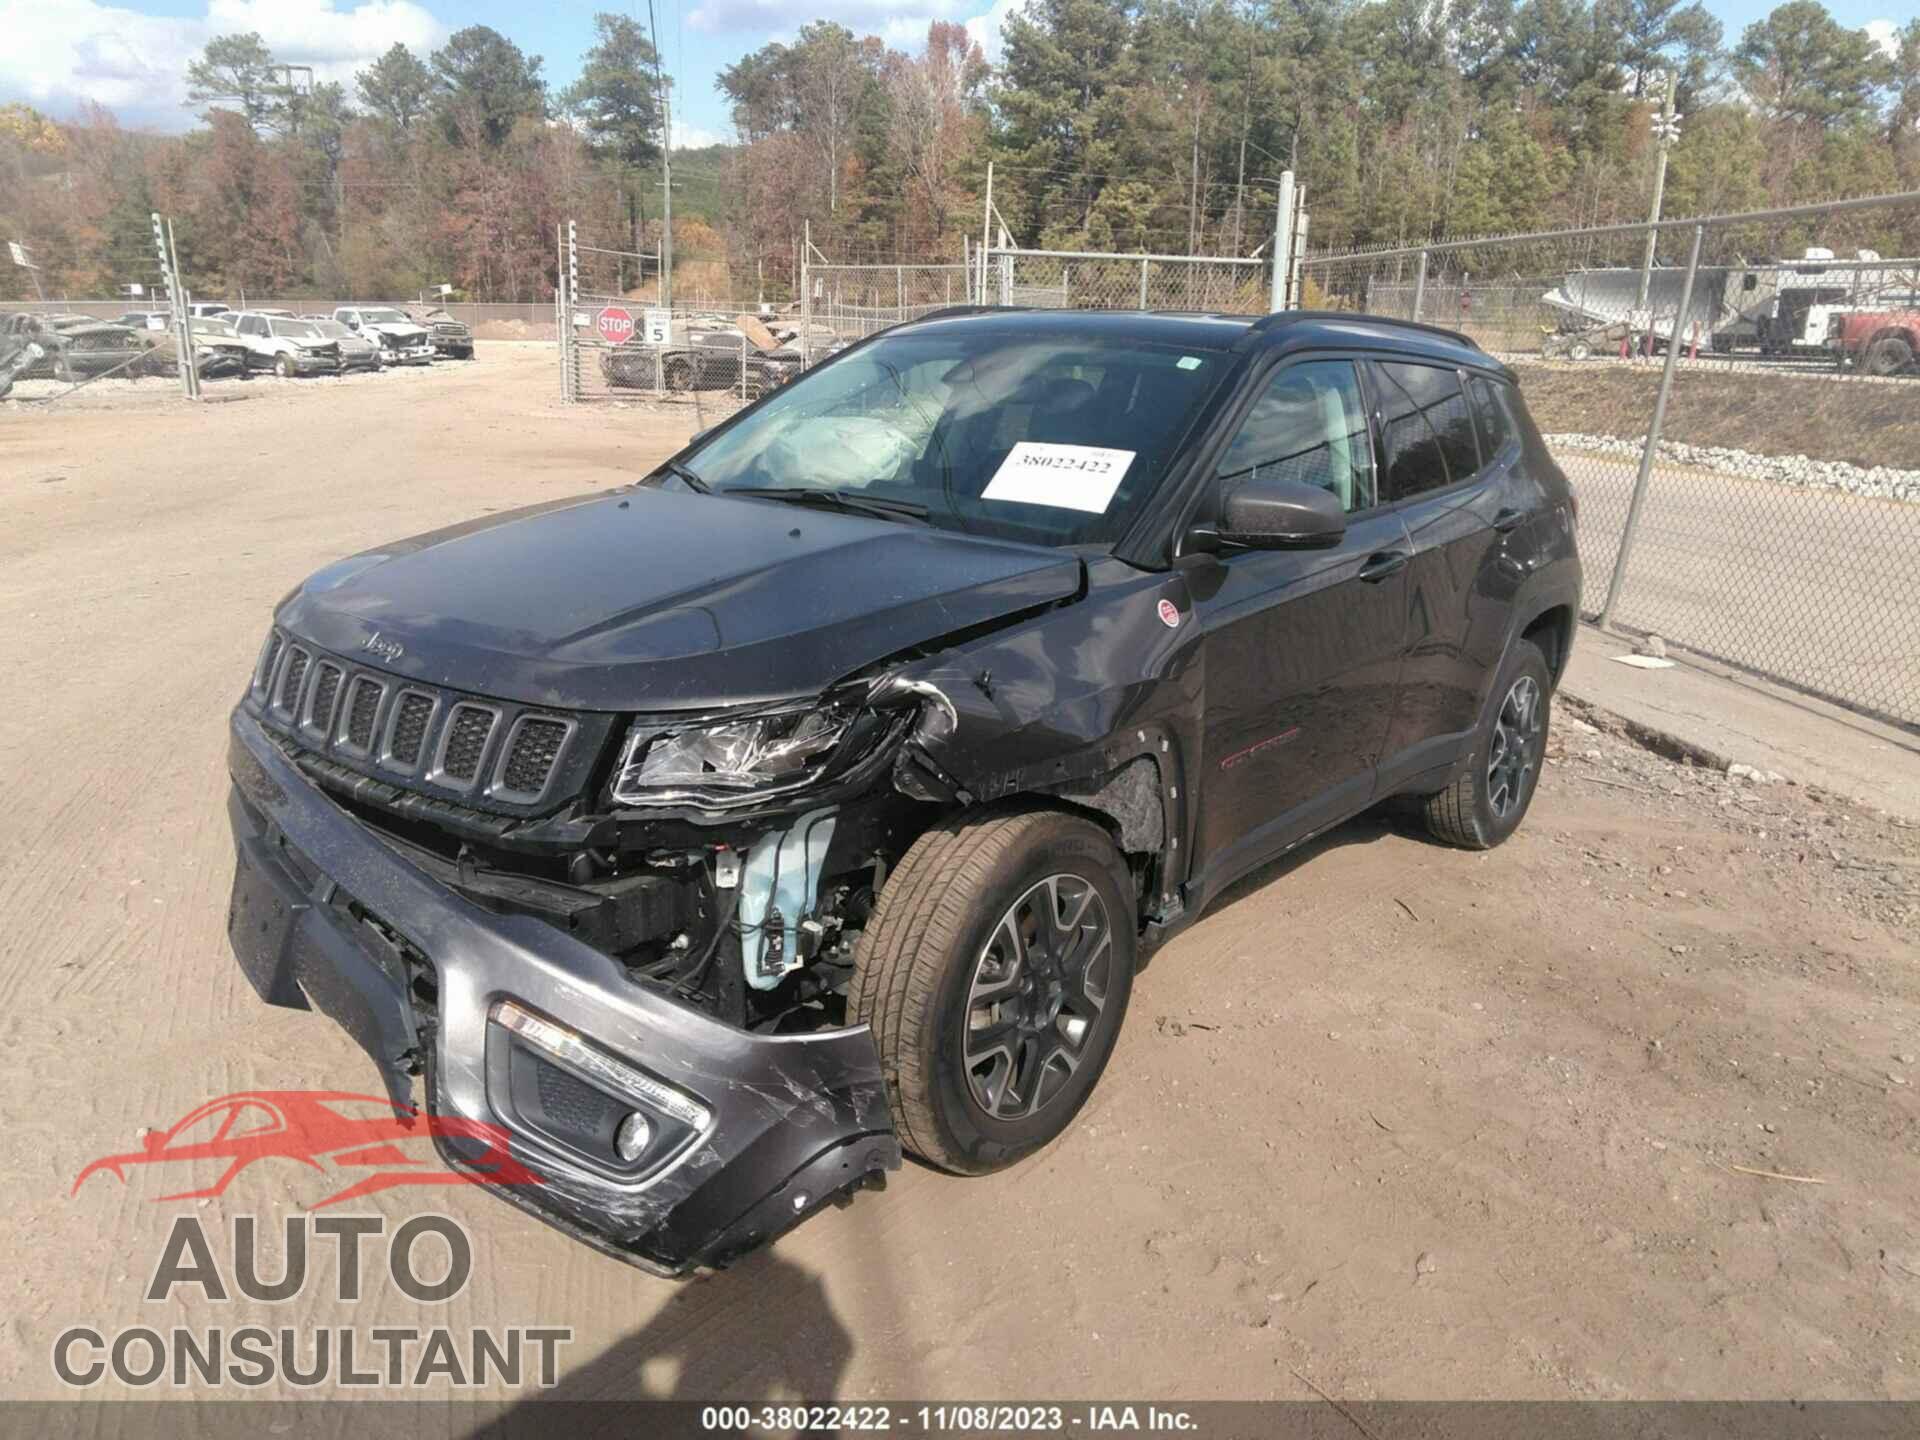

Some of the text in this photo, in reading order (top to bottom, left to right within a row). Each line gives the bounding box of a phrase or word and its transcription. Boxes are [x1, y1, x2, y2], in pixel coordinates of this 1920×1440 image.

[599, 317, 632, 333] STOP
[653, 328, 664, 341] 5
[1016, 453, 1113, 474] 38022422
[361, 631, 404, 664] Jeep
